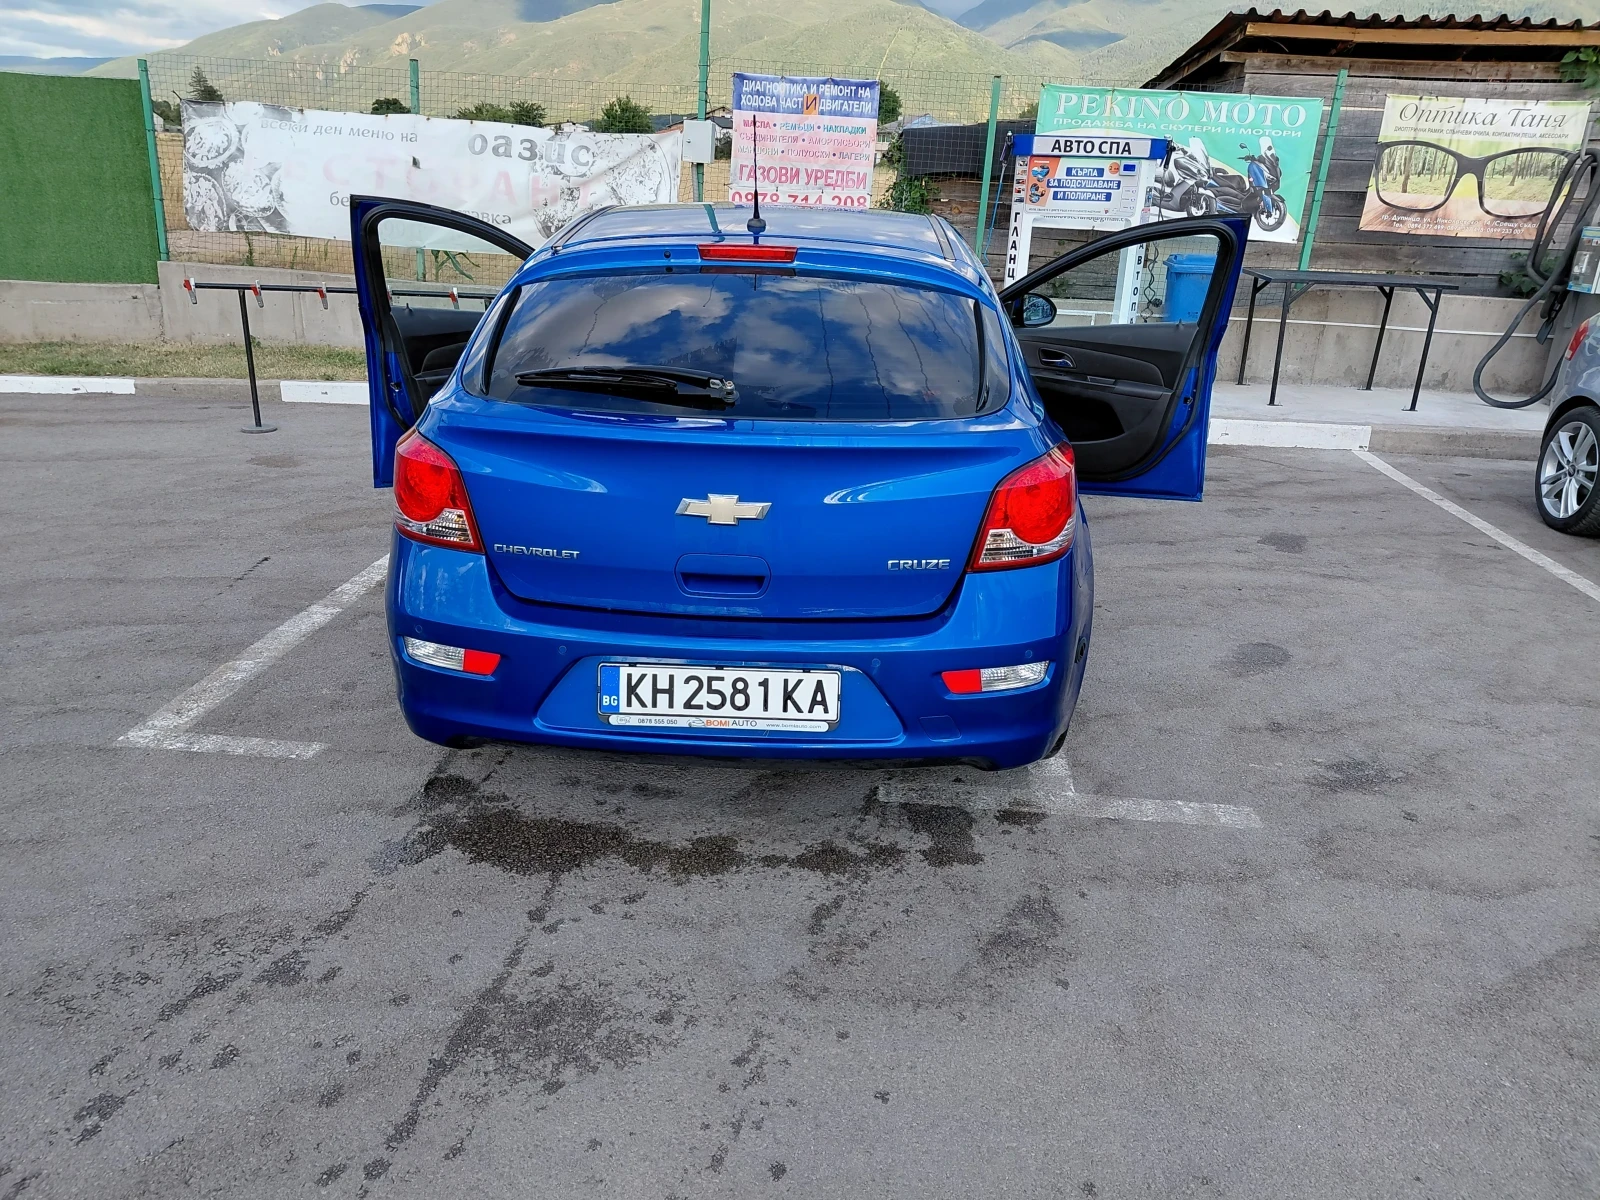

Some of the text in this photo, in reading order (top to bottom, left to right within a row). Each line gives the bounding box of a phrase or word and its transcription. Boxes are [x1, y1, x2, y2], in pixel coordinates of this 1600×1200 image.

[743, 80, 871, 99] ДИАГНОСТИКА И РЕМОНТ НА
[741, 94, 872, 113] ХОДОВА ЧАСТ И ДВИГАТЕЛИ
[1055, 92, 1307, 128] PEKINO MOTO
[1400, 102, 1574, 128] Оптика Таня
[261, 119, 418, 143] всеки ден меню на
[823, 124, 867, 136] НАКЛАДКИ
[1053, 117, 1302, 138] ПРОДАЖБА НА СКУТЕРИ И МОТОРИ
[467, 132, 594, 168] оазис
[1051, 139, 1132, 155] АВТО СПА
[839, 151, 871, 162] ЛАГЕРИ
[739, 164, 867, 191] ГАЗОВИ УРЕДБИ
[1071, 168, 1098, 177] КЪРПА
[1048, 179, 1118, 189] ЗА ПОДСУШАВАНЕ
[1057, 191, 1107, 201] И ПОЛИРАНЕ
[494, 543, 580, 559] CHEVROLET
[887, 559, 951, 571] CRUZE
[602, 695, 618, 706] BG
[705, 719, 758, 728] BOMI AUTO
